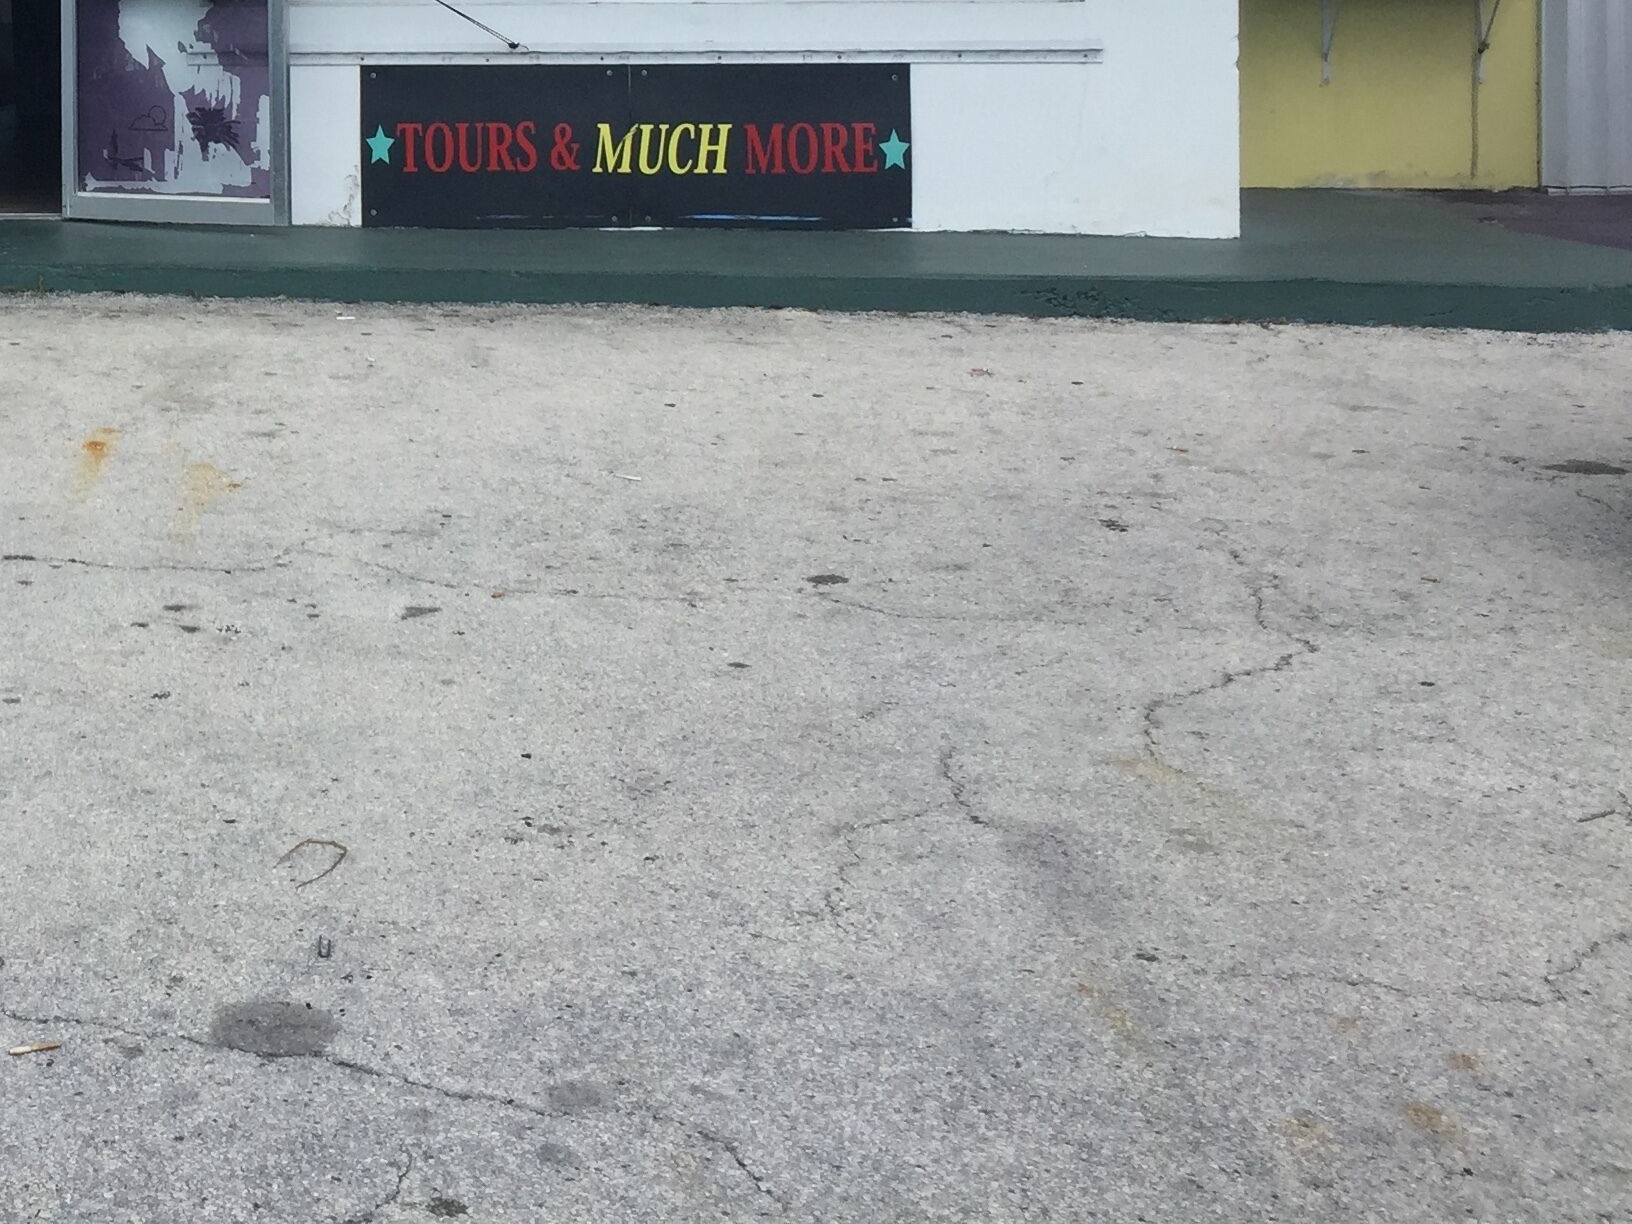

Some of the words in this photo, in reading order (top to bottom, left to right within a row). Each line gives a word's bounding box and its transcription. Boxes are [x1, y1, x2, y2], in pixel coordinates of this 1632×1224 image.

[396, 121, 537, 173] TOURS
[550, 122, 581, 172] &
[592, 122, 733, 175] MUCH
[744, 122, 878, 174] MORE
